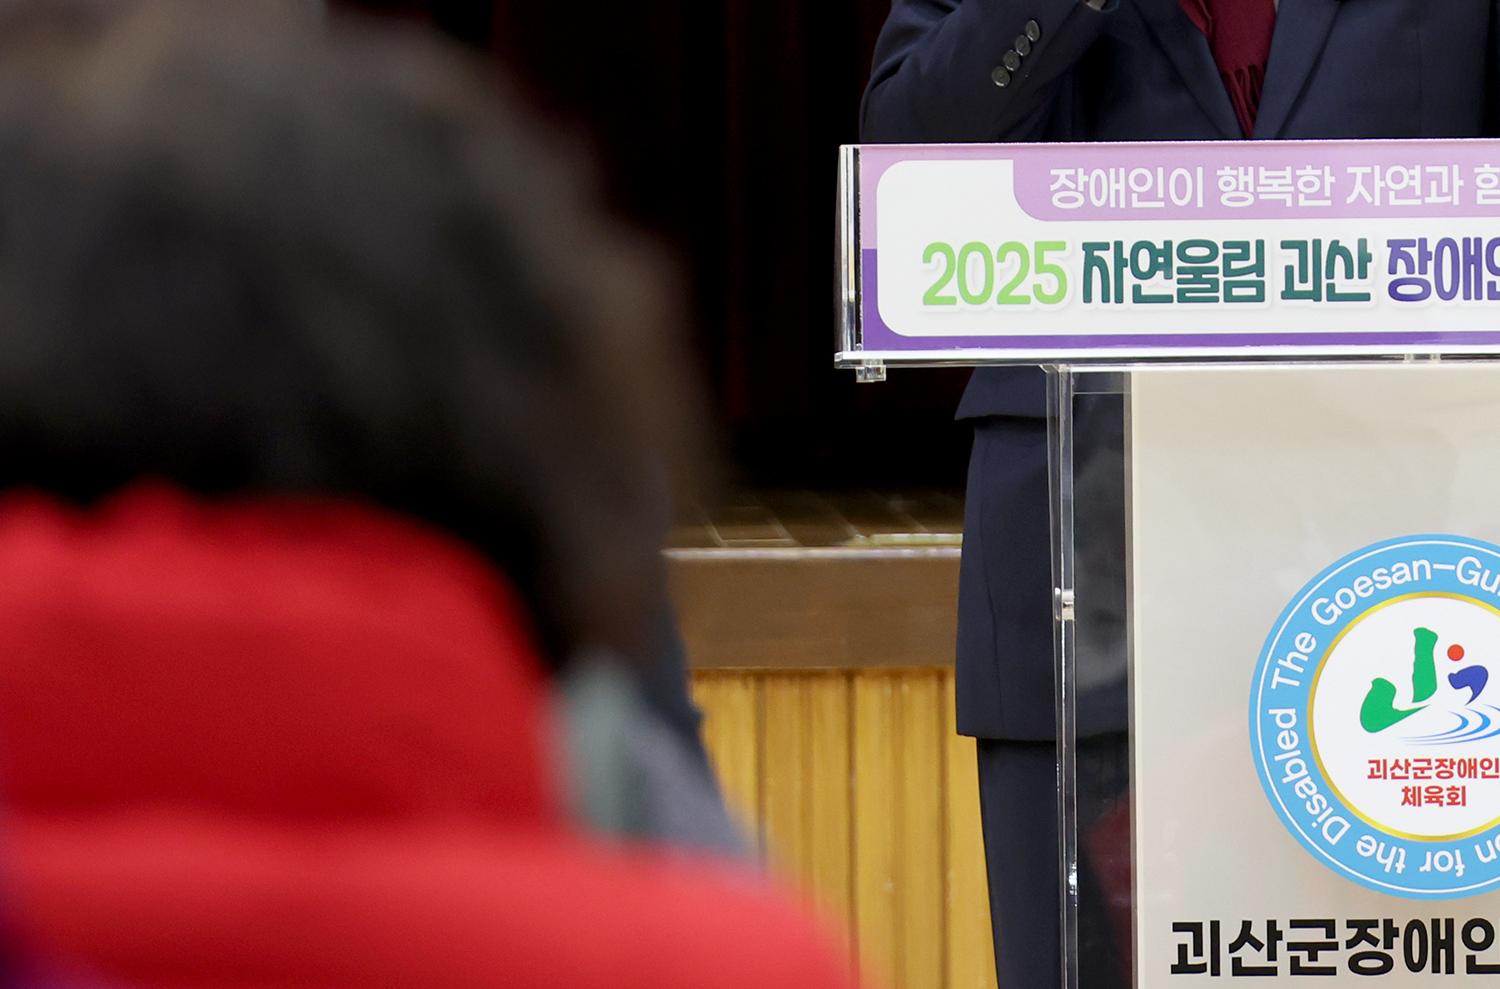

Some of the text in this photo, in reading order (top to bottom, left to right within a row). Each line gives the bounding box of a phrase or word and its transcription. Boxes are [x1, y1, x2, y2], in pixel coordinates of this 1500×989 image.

[1048, 167, 1204, 209] 장애인이
[1217, 165, 1336, 208] 행복한
[1346, 164, 1464, 207] 자연과
[922, 240, 1068, 305] 2025
[1081, 237, 1266, 304] 자연울림
[1280, 237, 1373, 303] 괴산
[1271, 632, 1317, 690] The
[1268, 708, 1351, 846] Disabled
[1367, 757, 1500, 780] 괴산군장애인
[1401, 785, 1467, 808] 체육회
[1356, 834, 1407, 874] the
[1419, 849, 1465, 877] for
